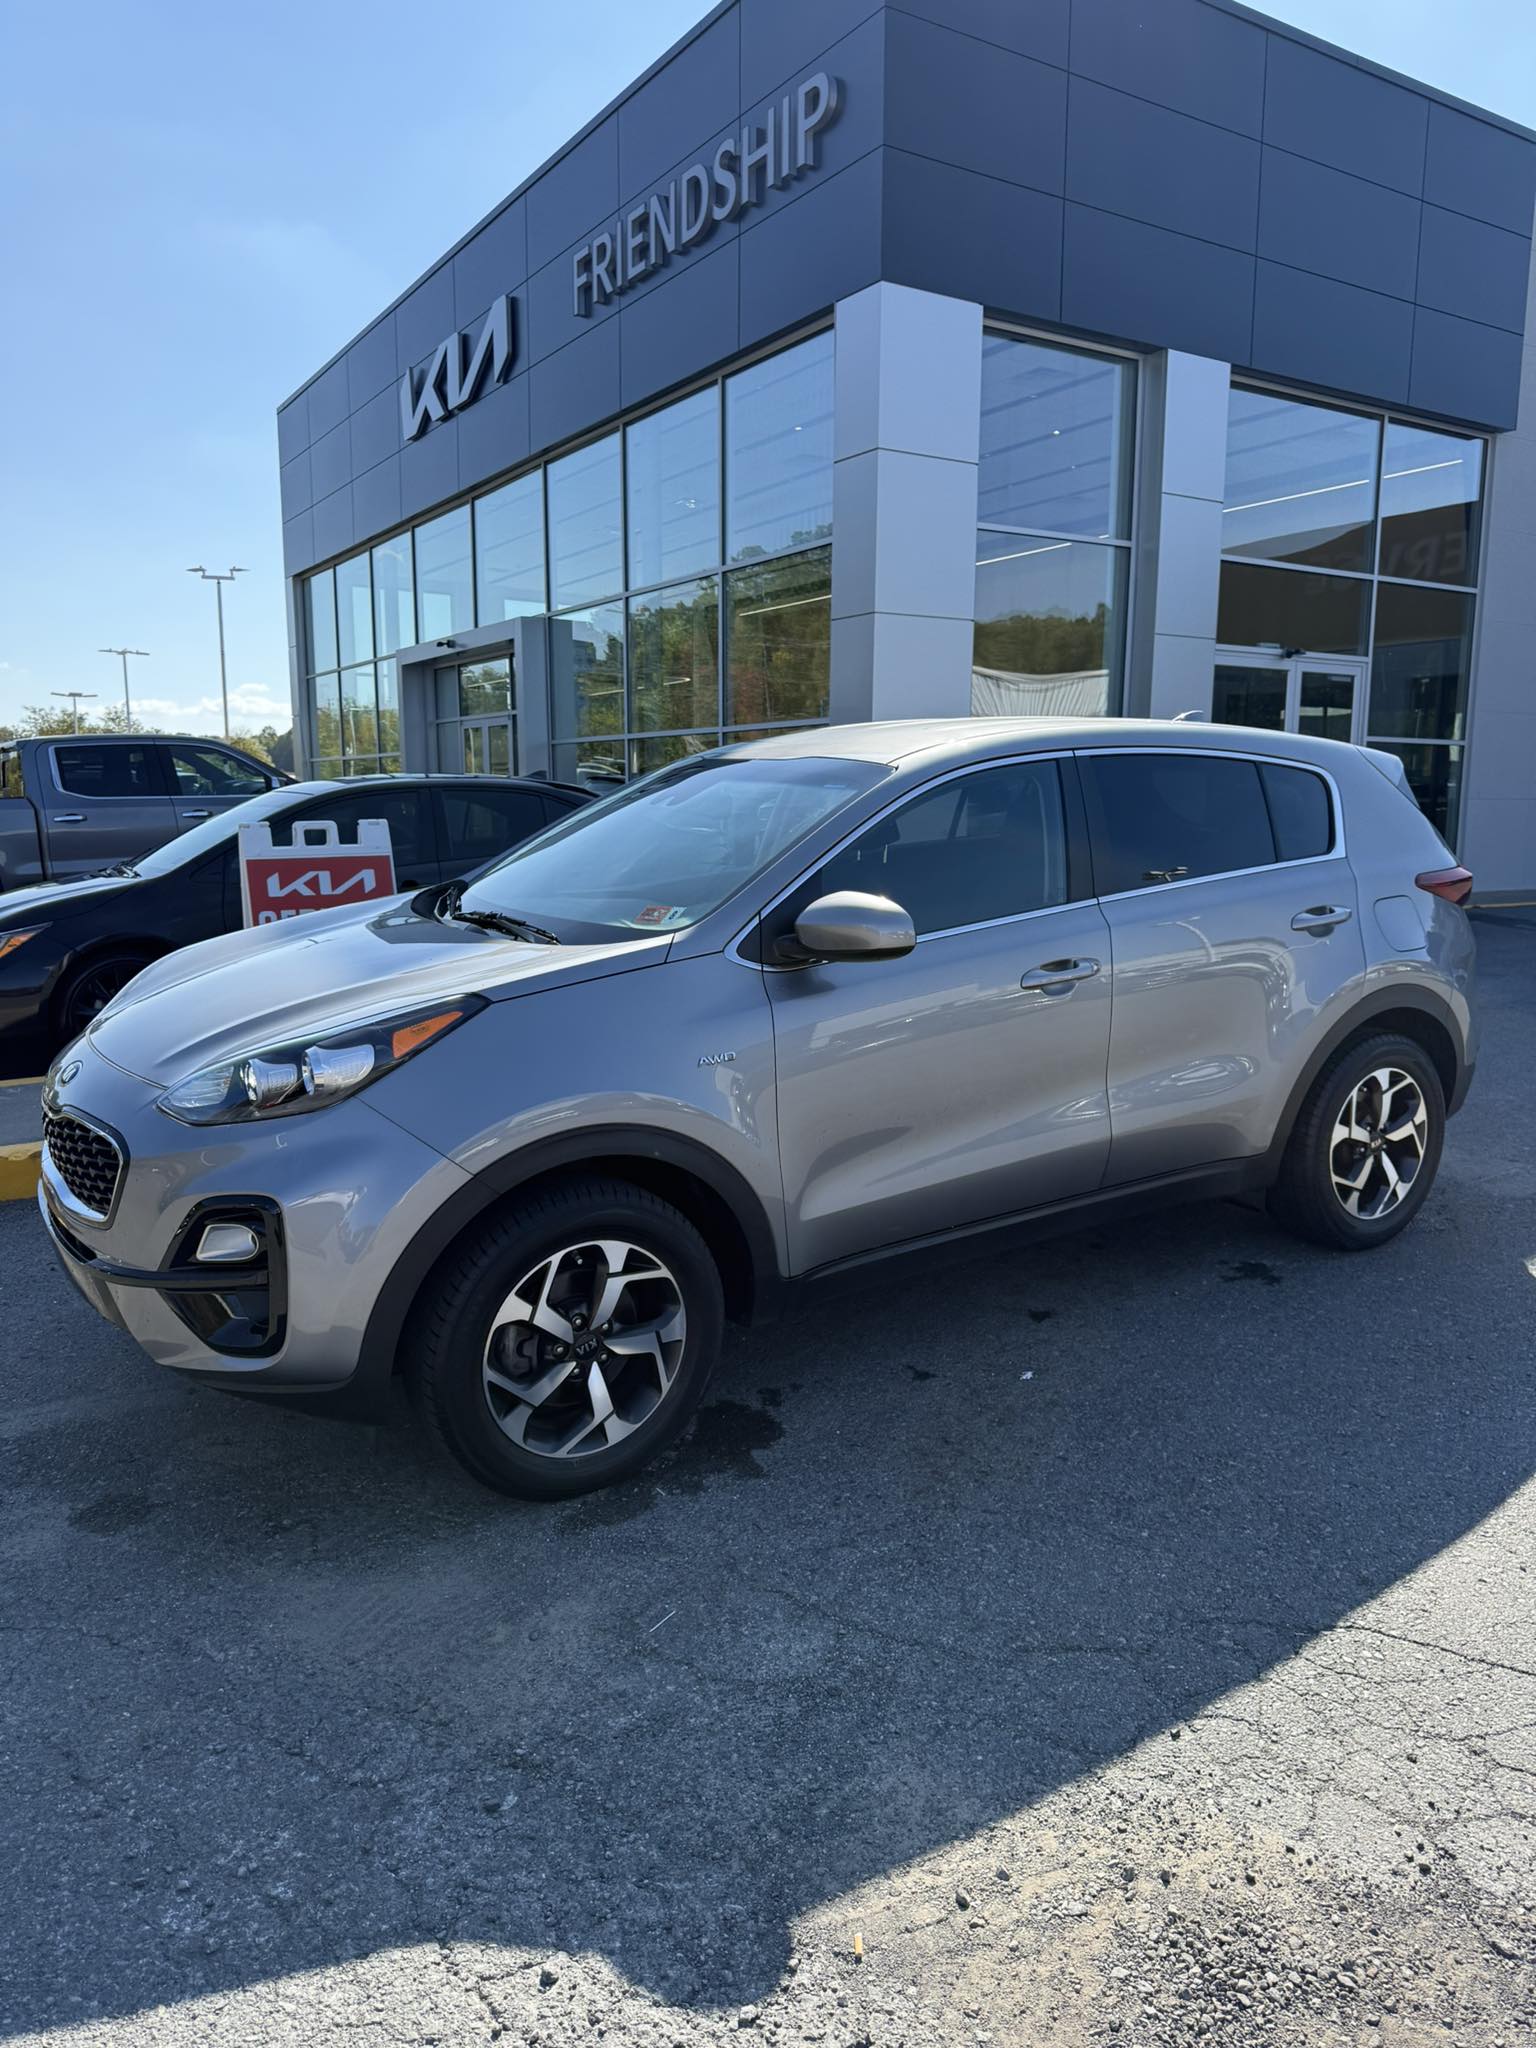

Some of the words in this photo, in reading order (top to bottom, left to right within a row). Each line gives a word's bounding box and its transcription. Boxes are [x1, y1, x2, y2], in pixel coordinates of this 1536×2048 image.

[573, 72, 838, 318] FRIENDSHIP
[402, 294, 513, 441] KIA
[266, 868, 377, 898] KIA
[697, 1051, 736, 1068] AWD
[575, 1338, 598, 1355] KIA
